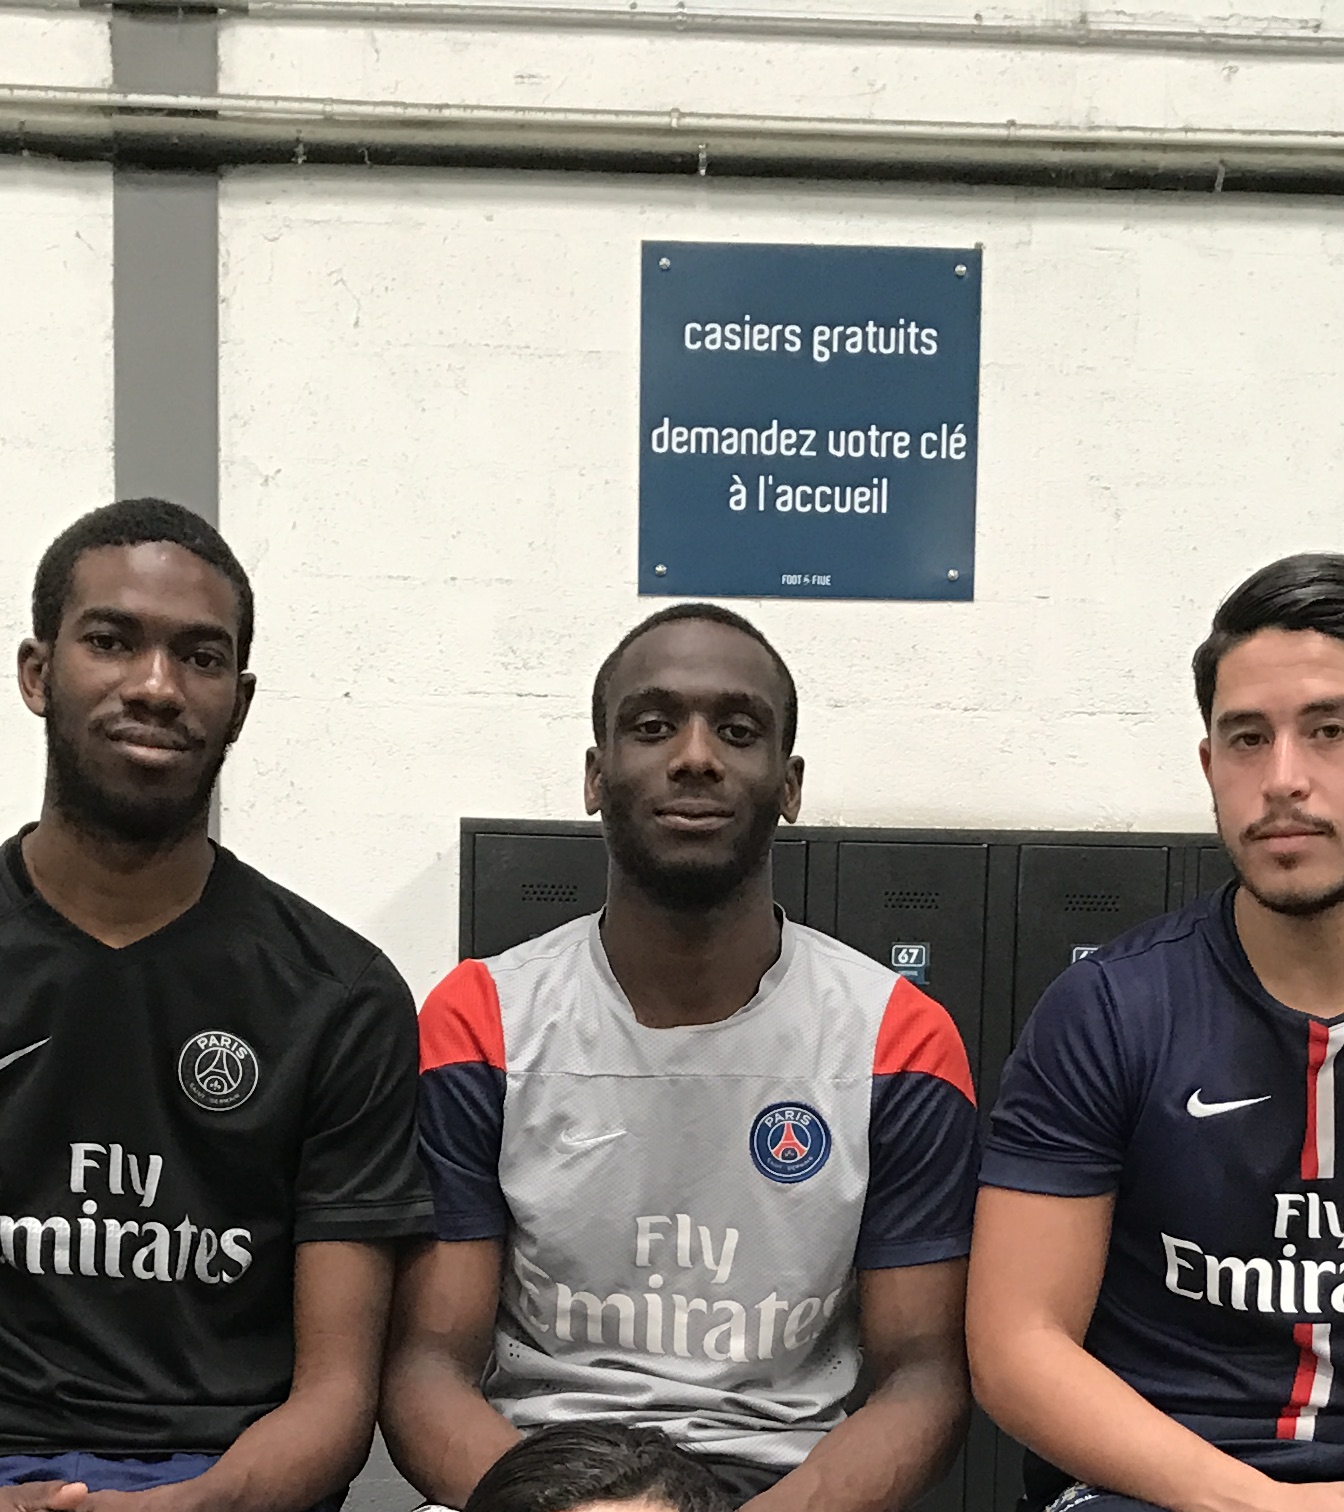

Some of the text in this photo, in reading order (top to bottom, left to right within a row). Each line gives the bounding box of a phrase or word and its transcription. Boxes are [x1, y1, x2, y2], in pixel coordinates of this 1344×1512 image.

[684, 314, 939, 363] casiers gratuits
[651, 417, 967, 460] demandez votre clé
[729, 475, 888, 514] à l'accueil
[781, 574, 802, 585] FOOT
[898, 949, 920, 964] 67
[196, 1035, 248, 1060] PARIS
[764, 1110, 812, 1127] PARIS
[69, 1142, 163, 1208] Fly
[635, 1213, 739, 1284] Fly
